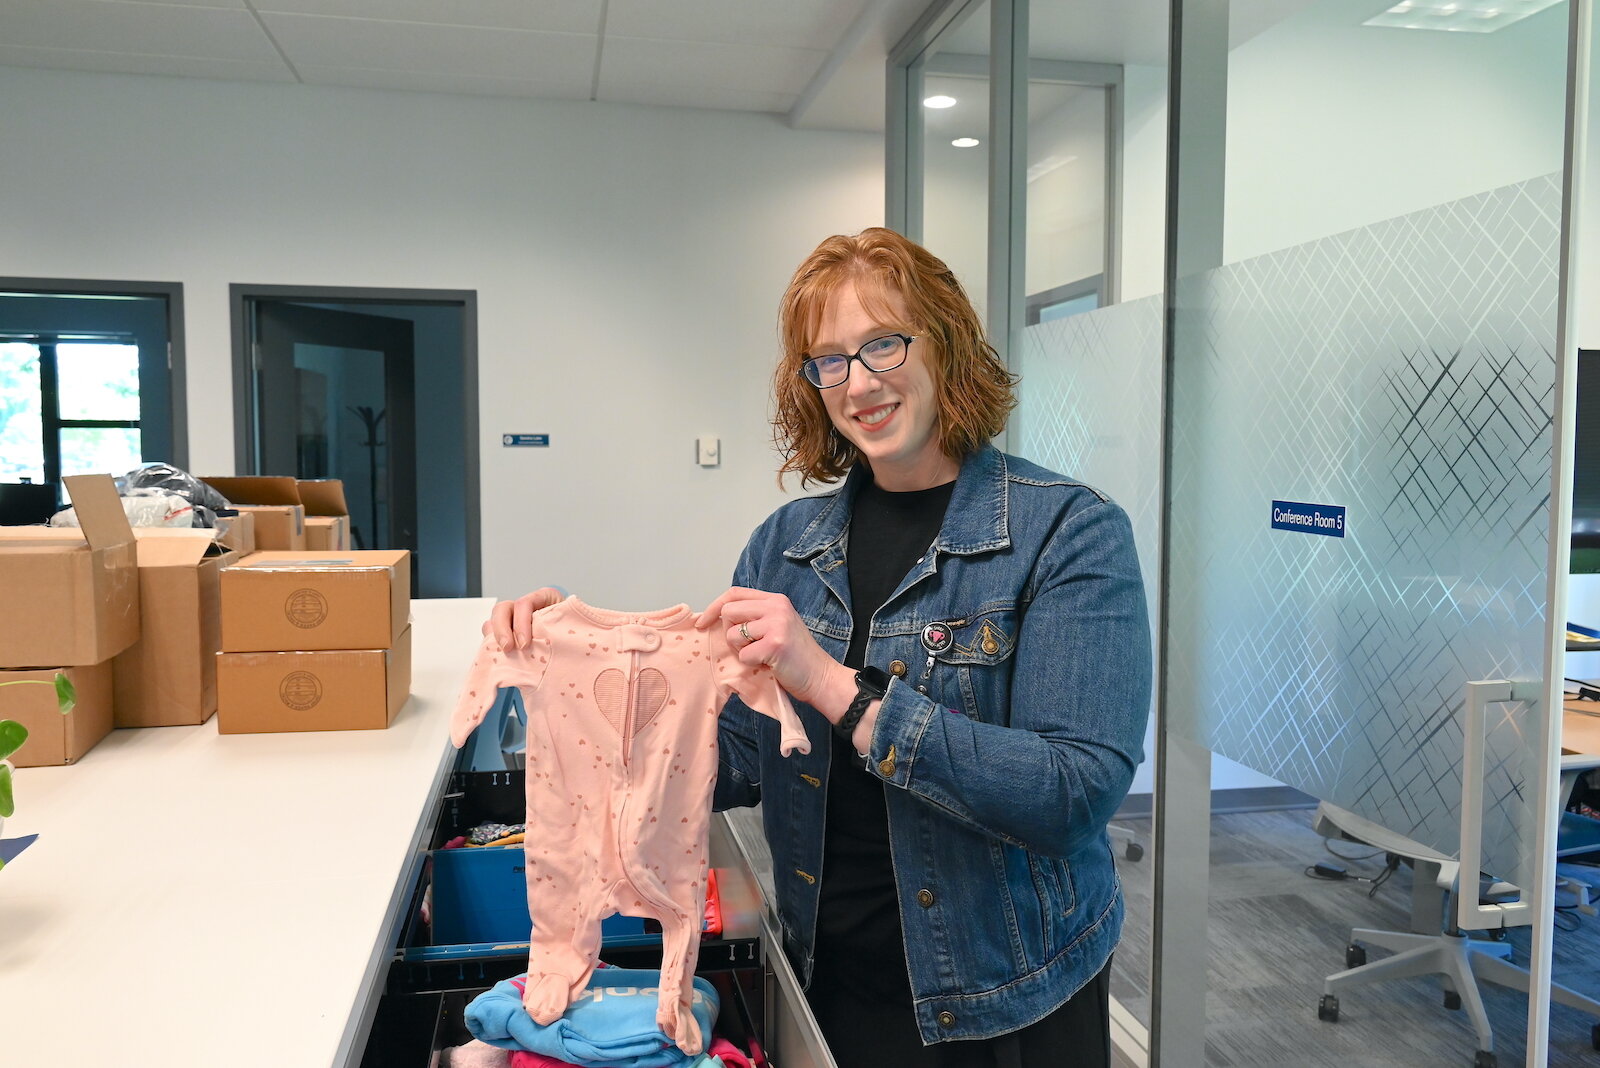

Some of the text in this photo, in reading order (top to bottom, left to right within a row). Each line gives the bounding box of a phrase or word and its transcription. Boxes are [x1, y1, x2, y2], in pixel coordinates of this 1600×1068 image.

[1274, 507, 1343, 530] Conference Room 5
